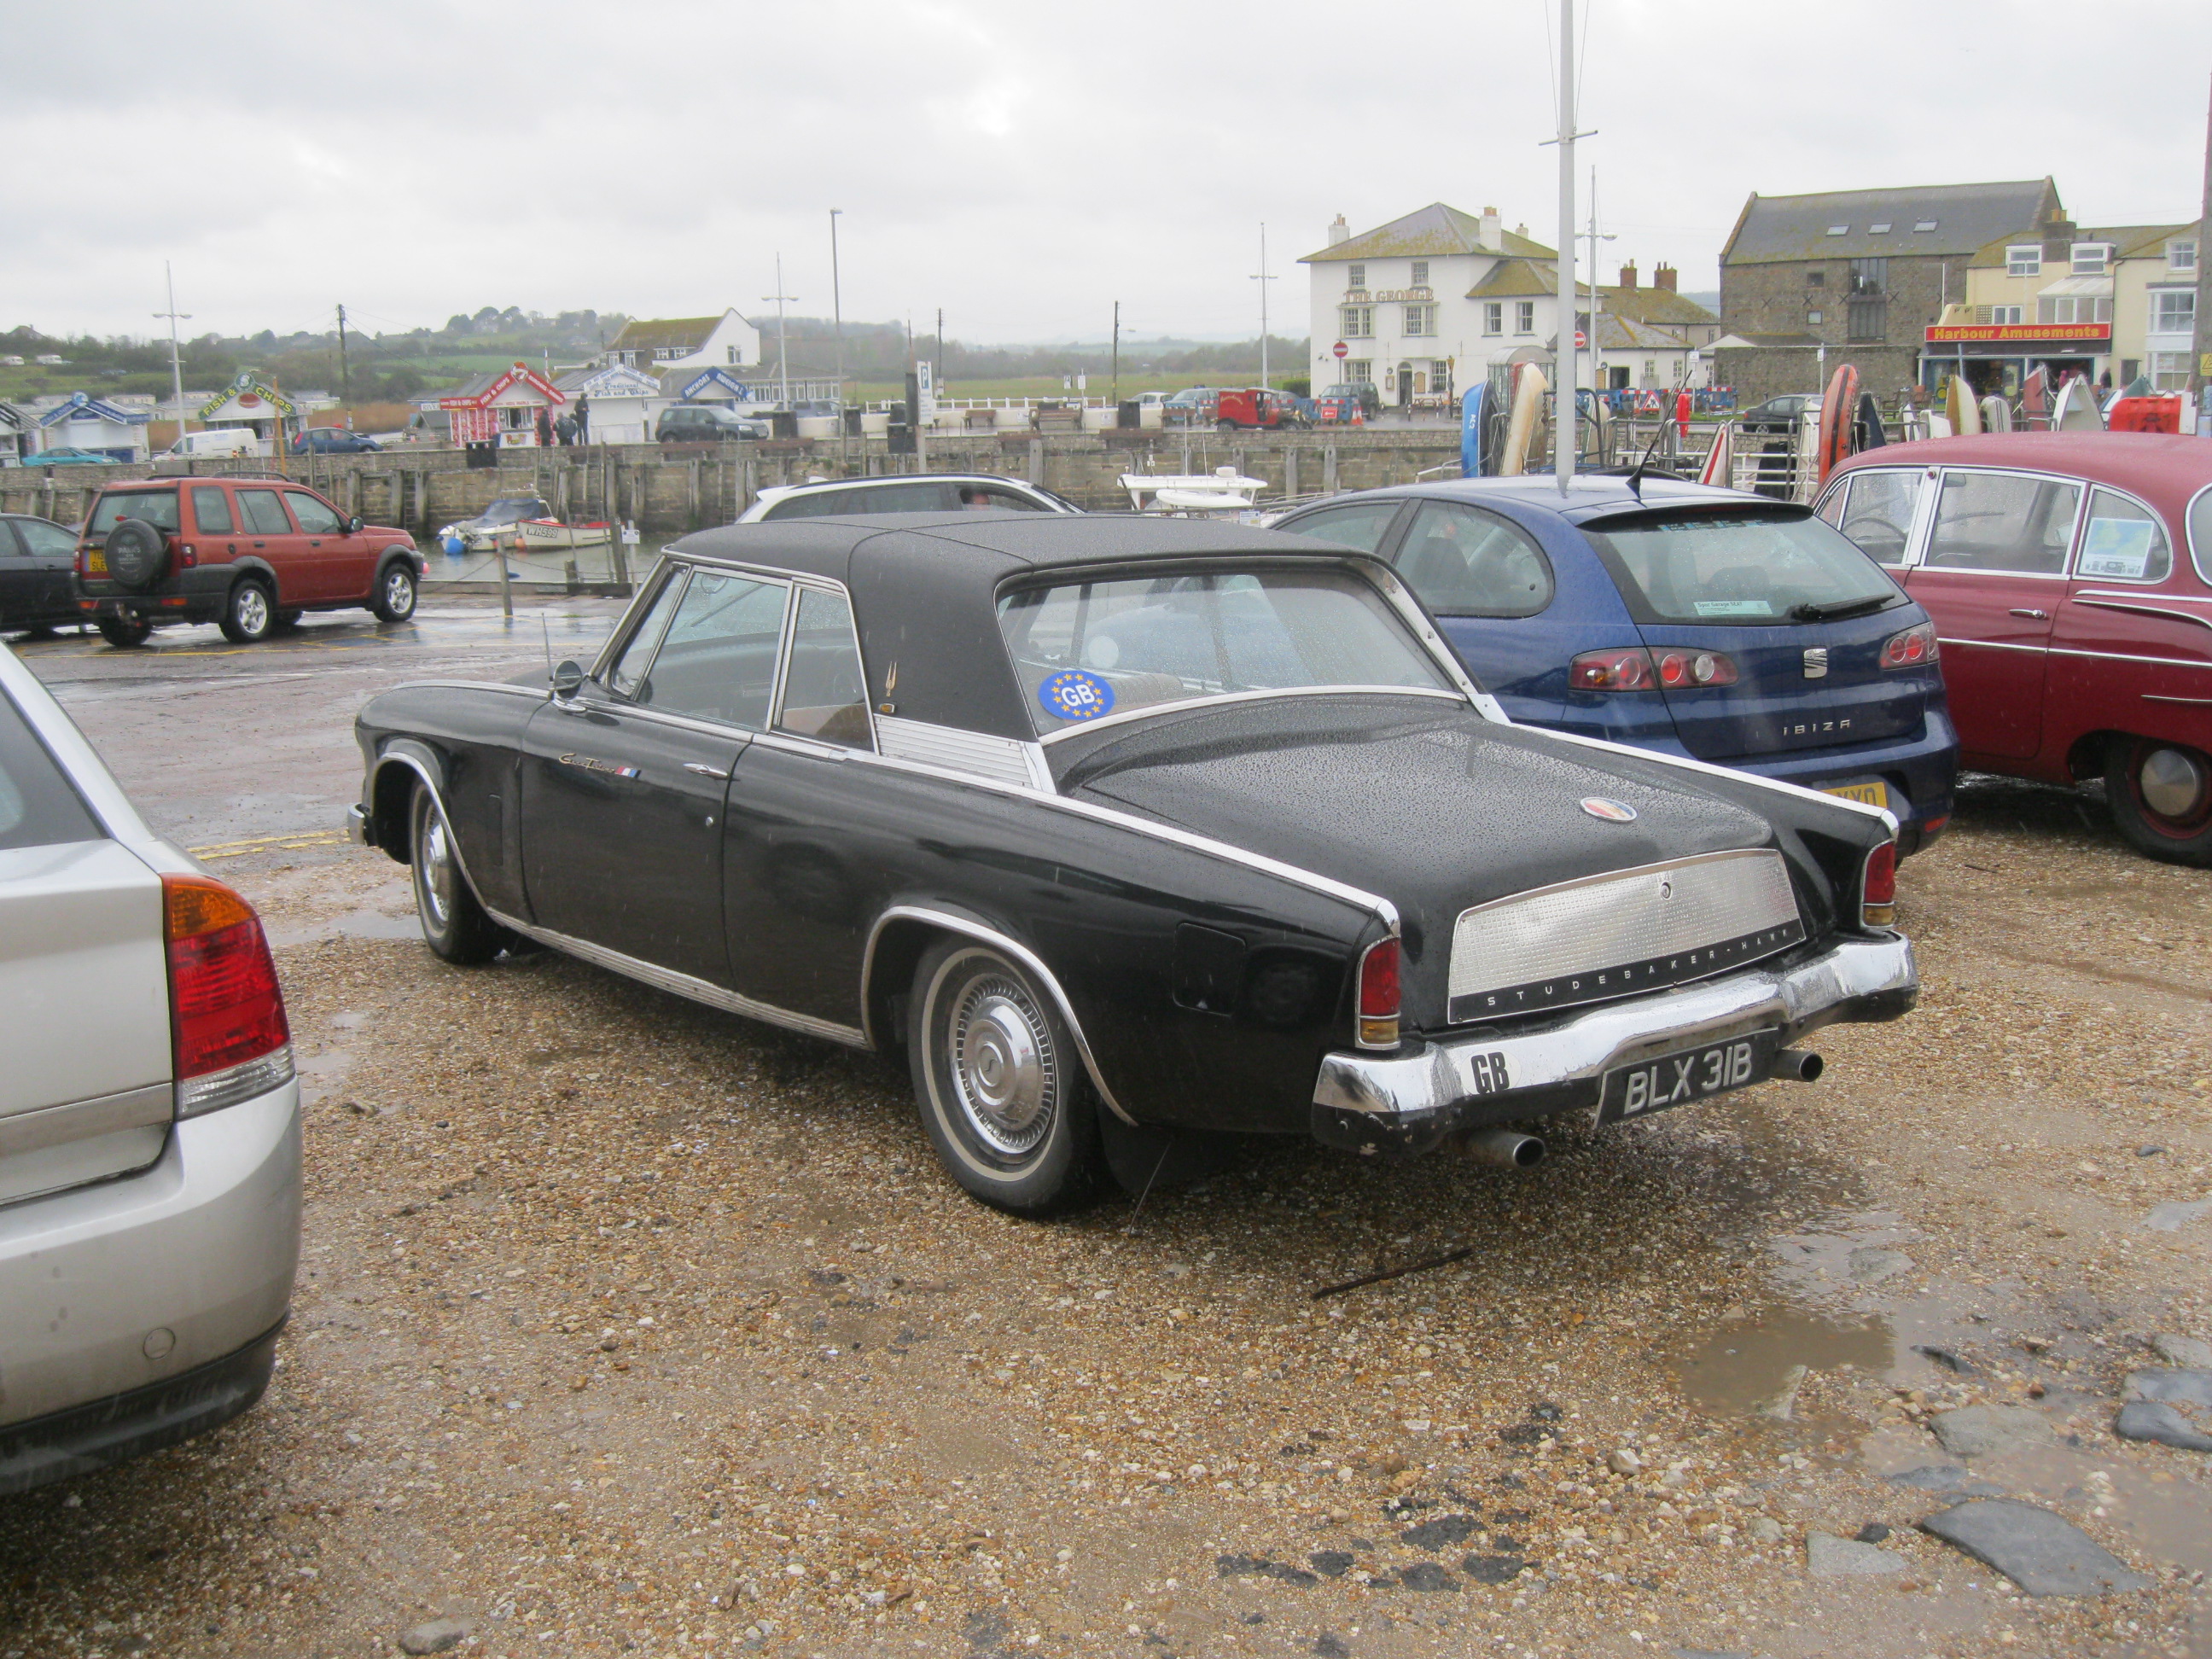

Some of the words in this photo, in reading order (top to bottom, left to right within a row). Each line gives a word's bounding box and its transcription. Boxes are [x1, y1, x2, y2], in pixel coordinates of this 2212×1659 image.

[1343, 290, 1371, 302] THE
[1376, 289, 1434, 302] GEORGE
[1934, 329, 1994, 340] Harbour
[1999, 326, 2099, 339] Amusements
[684, 373, 711, 398] ANCHORS
[923, 368, 928, 387] P
[203, 395, 227, 416] FISH
[227, 388, 236, 397] &
[256, 387, 293, 412] CHIPS
[480, 393, 492, 405] FISH
[496, 376, 510, 391] CHIPS
[527, 527, 558, 538] WH599
[1062, 684, 1095, 707] GB
[1784, 719, 1850, 736] IBIZA
[1470, 1051, 1511, 1095] GB
[1624, 1056, 1696, 1115] BLX
[1701, 1042, 1753, 1091] 31B
